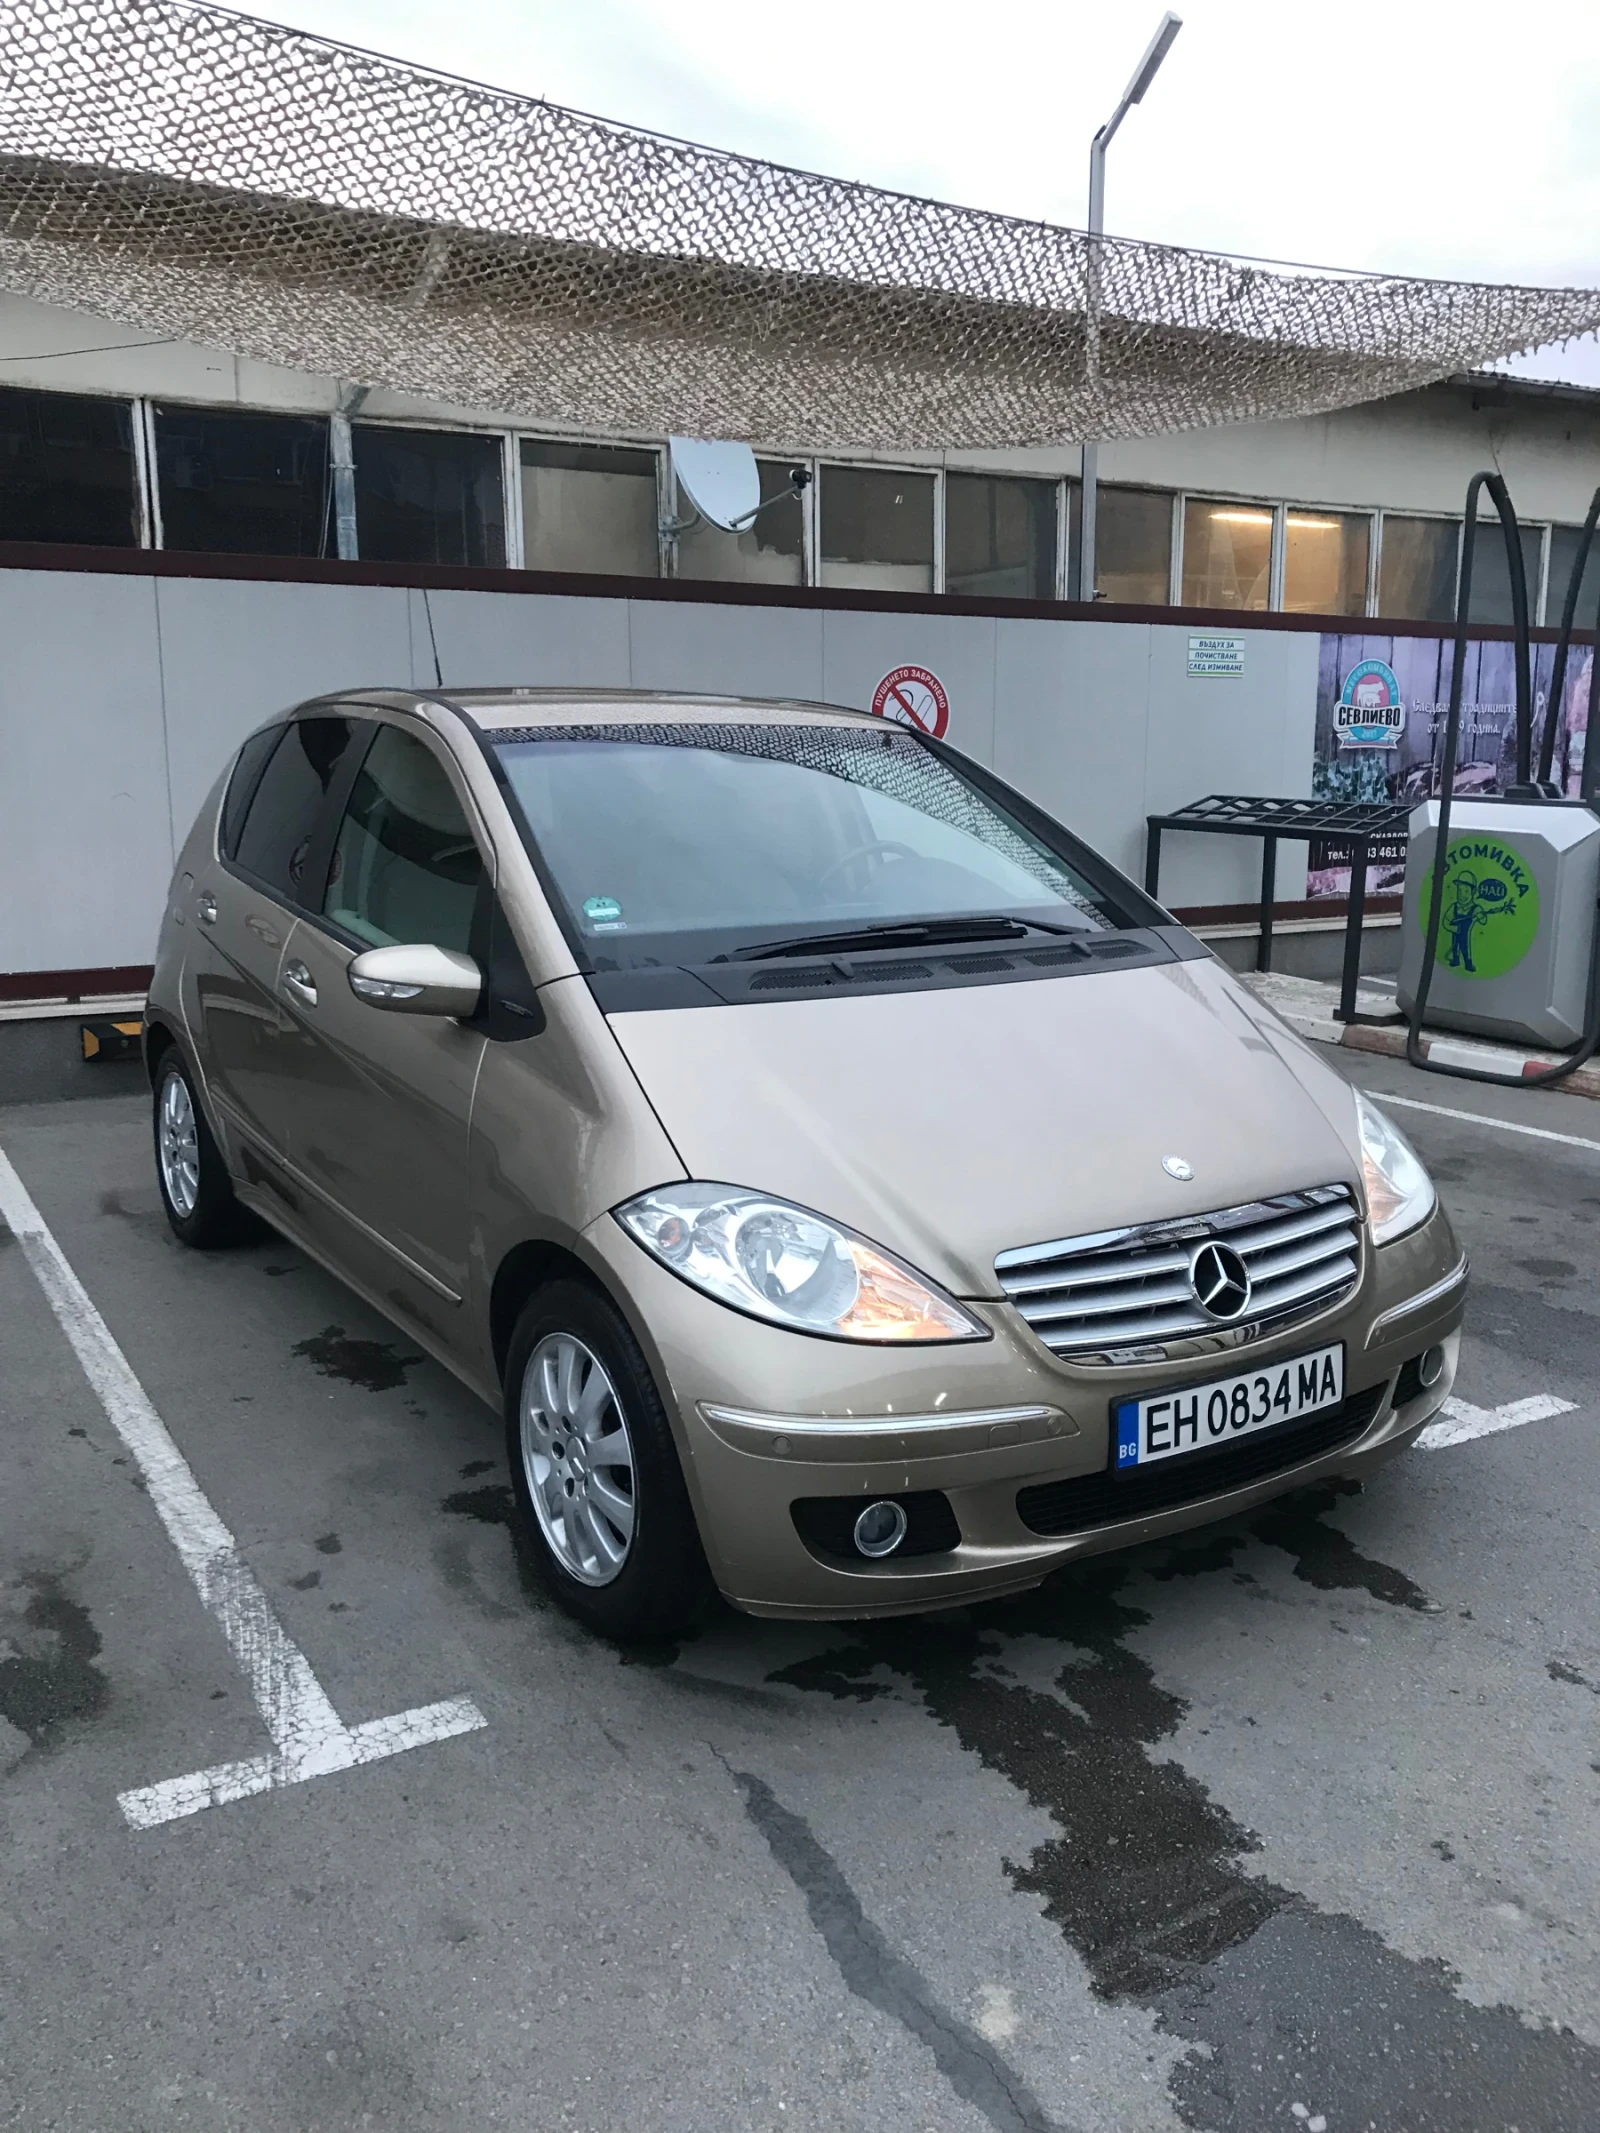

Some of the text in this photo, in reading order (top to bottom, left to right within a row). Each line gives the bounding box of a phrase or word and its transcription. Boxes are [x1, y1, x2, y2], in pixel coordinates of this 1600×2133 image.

[1199, 641, 1235, 649] ВЪЗДУХ ЗА
[1195, 652, 1238, 660] ПОЧИСТВАНЕ
[1189, 663, 1243, 671] СЛЕД ИЗМИВАНЕ
[875, 669, 946, 708] ПУШЕНЕТО ЗАБРАНЕНО
[1338, 706, 1400, 726] СЕВЛИЕВО
[1427, 723, 1439, 734] от
[1379, 846, 1398, 858] 461
[1207, 1368, 1292, 1436] 0834
[1119, 1442, 1137, 1459] BG
